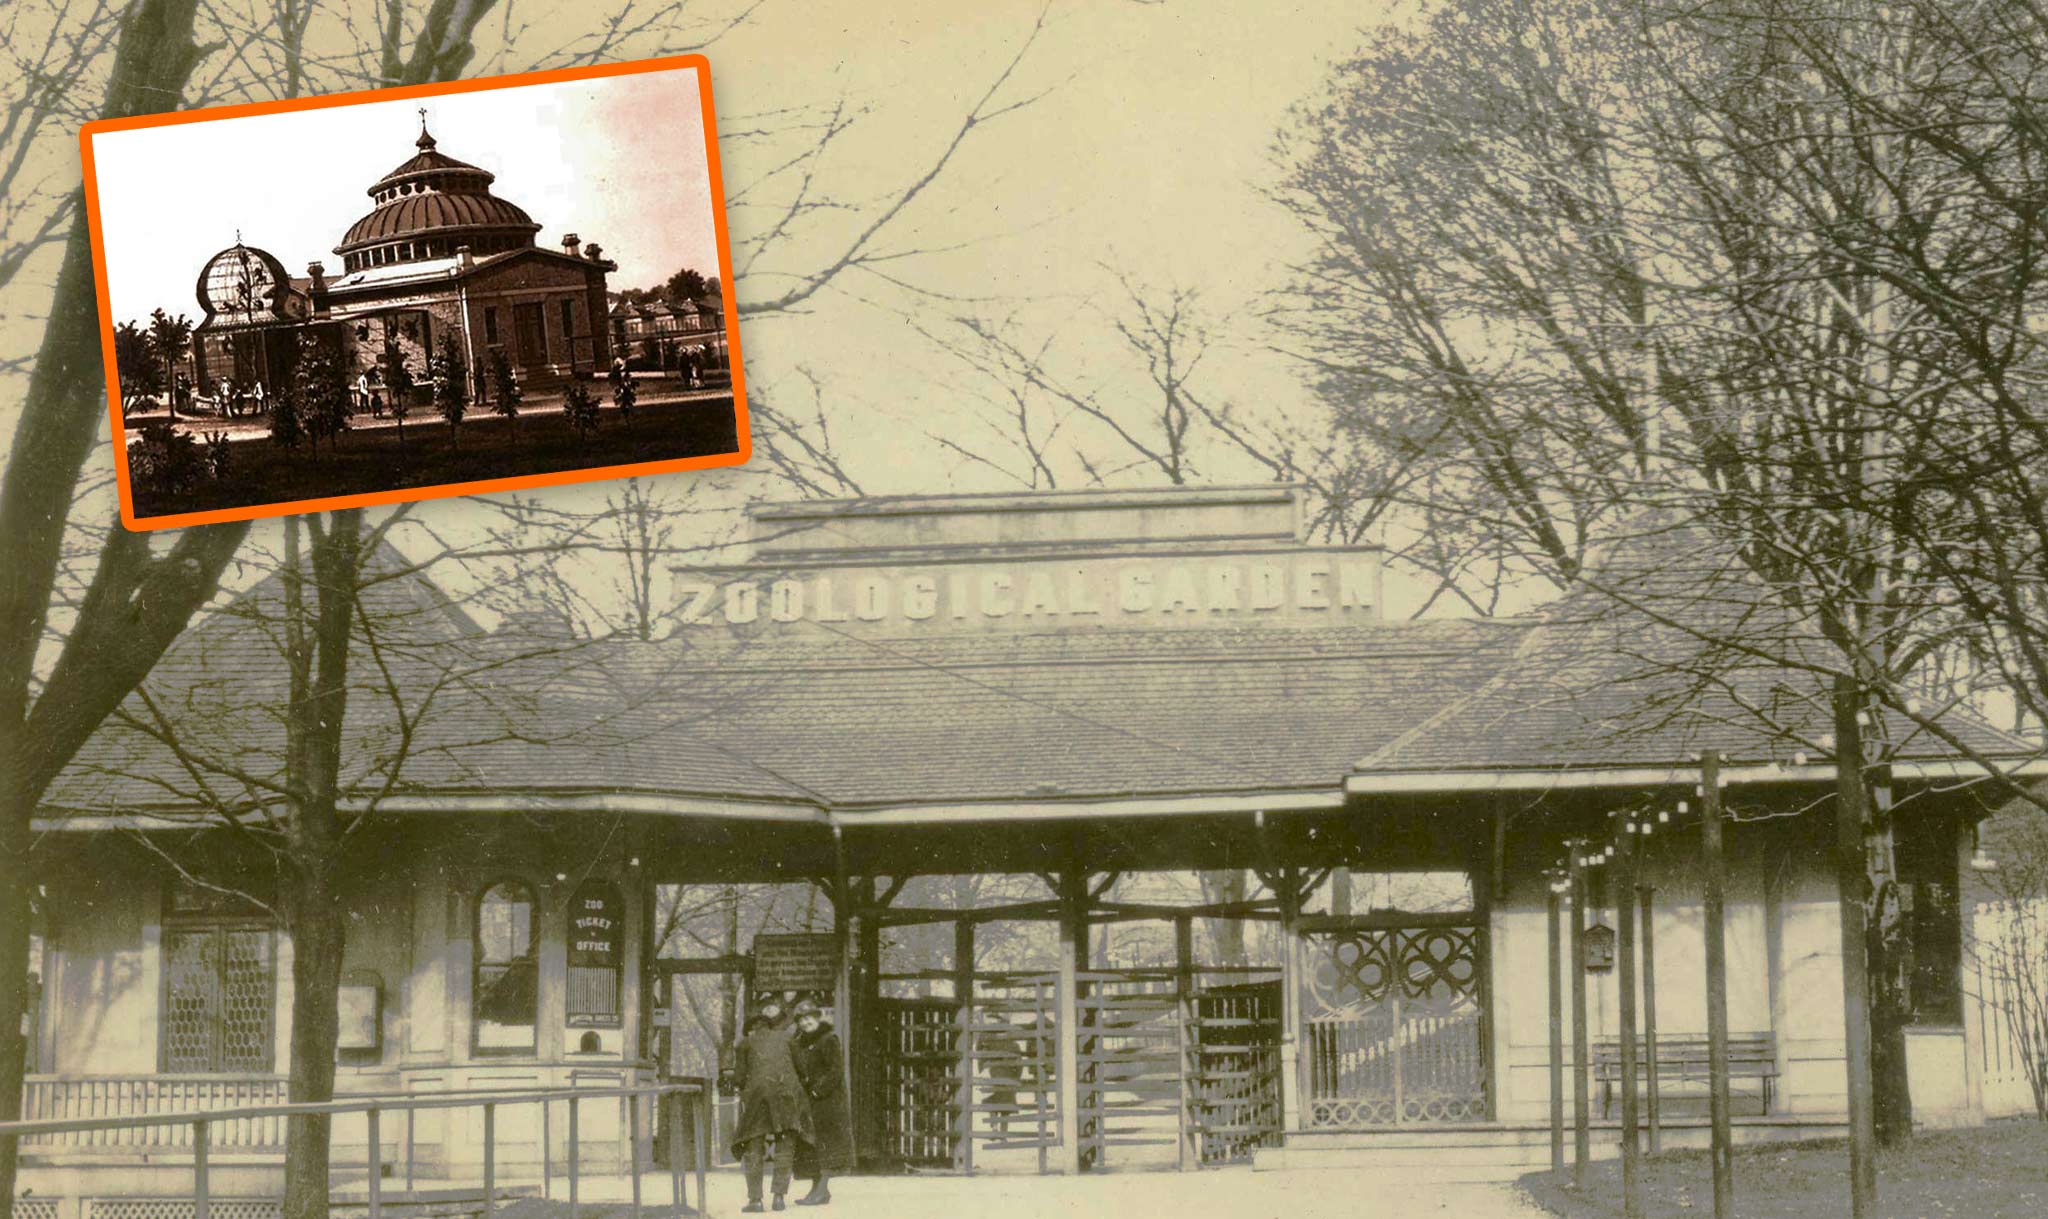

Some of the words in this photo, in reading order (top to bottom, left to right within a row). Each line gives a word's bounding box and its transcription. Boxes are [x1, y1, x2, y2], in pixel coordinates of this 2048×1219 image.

[680, 570, 1099, 625] ZOOLOGICAL
[1119, 562, 1374, 613] GARDEN
[585, 900, 604, 910] ZOO
[576, 917, 611, 929] TICKET
[576, 941, 611, 952] OFFICE
